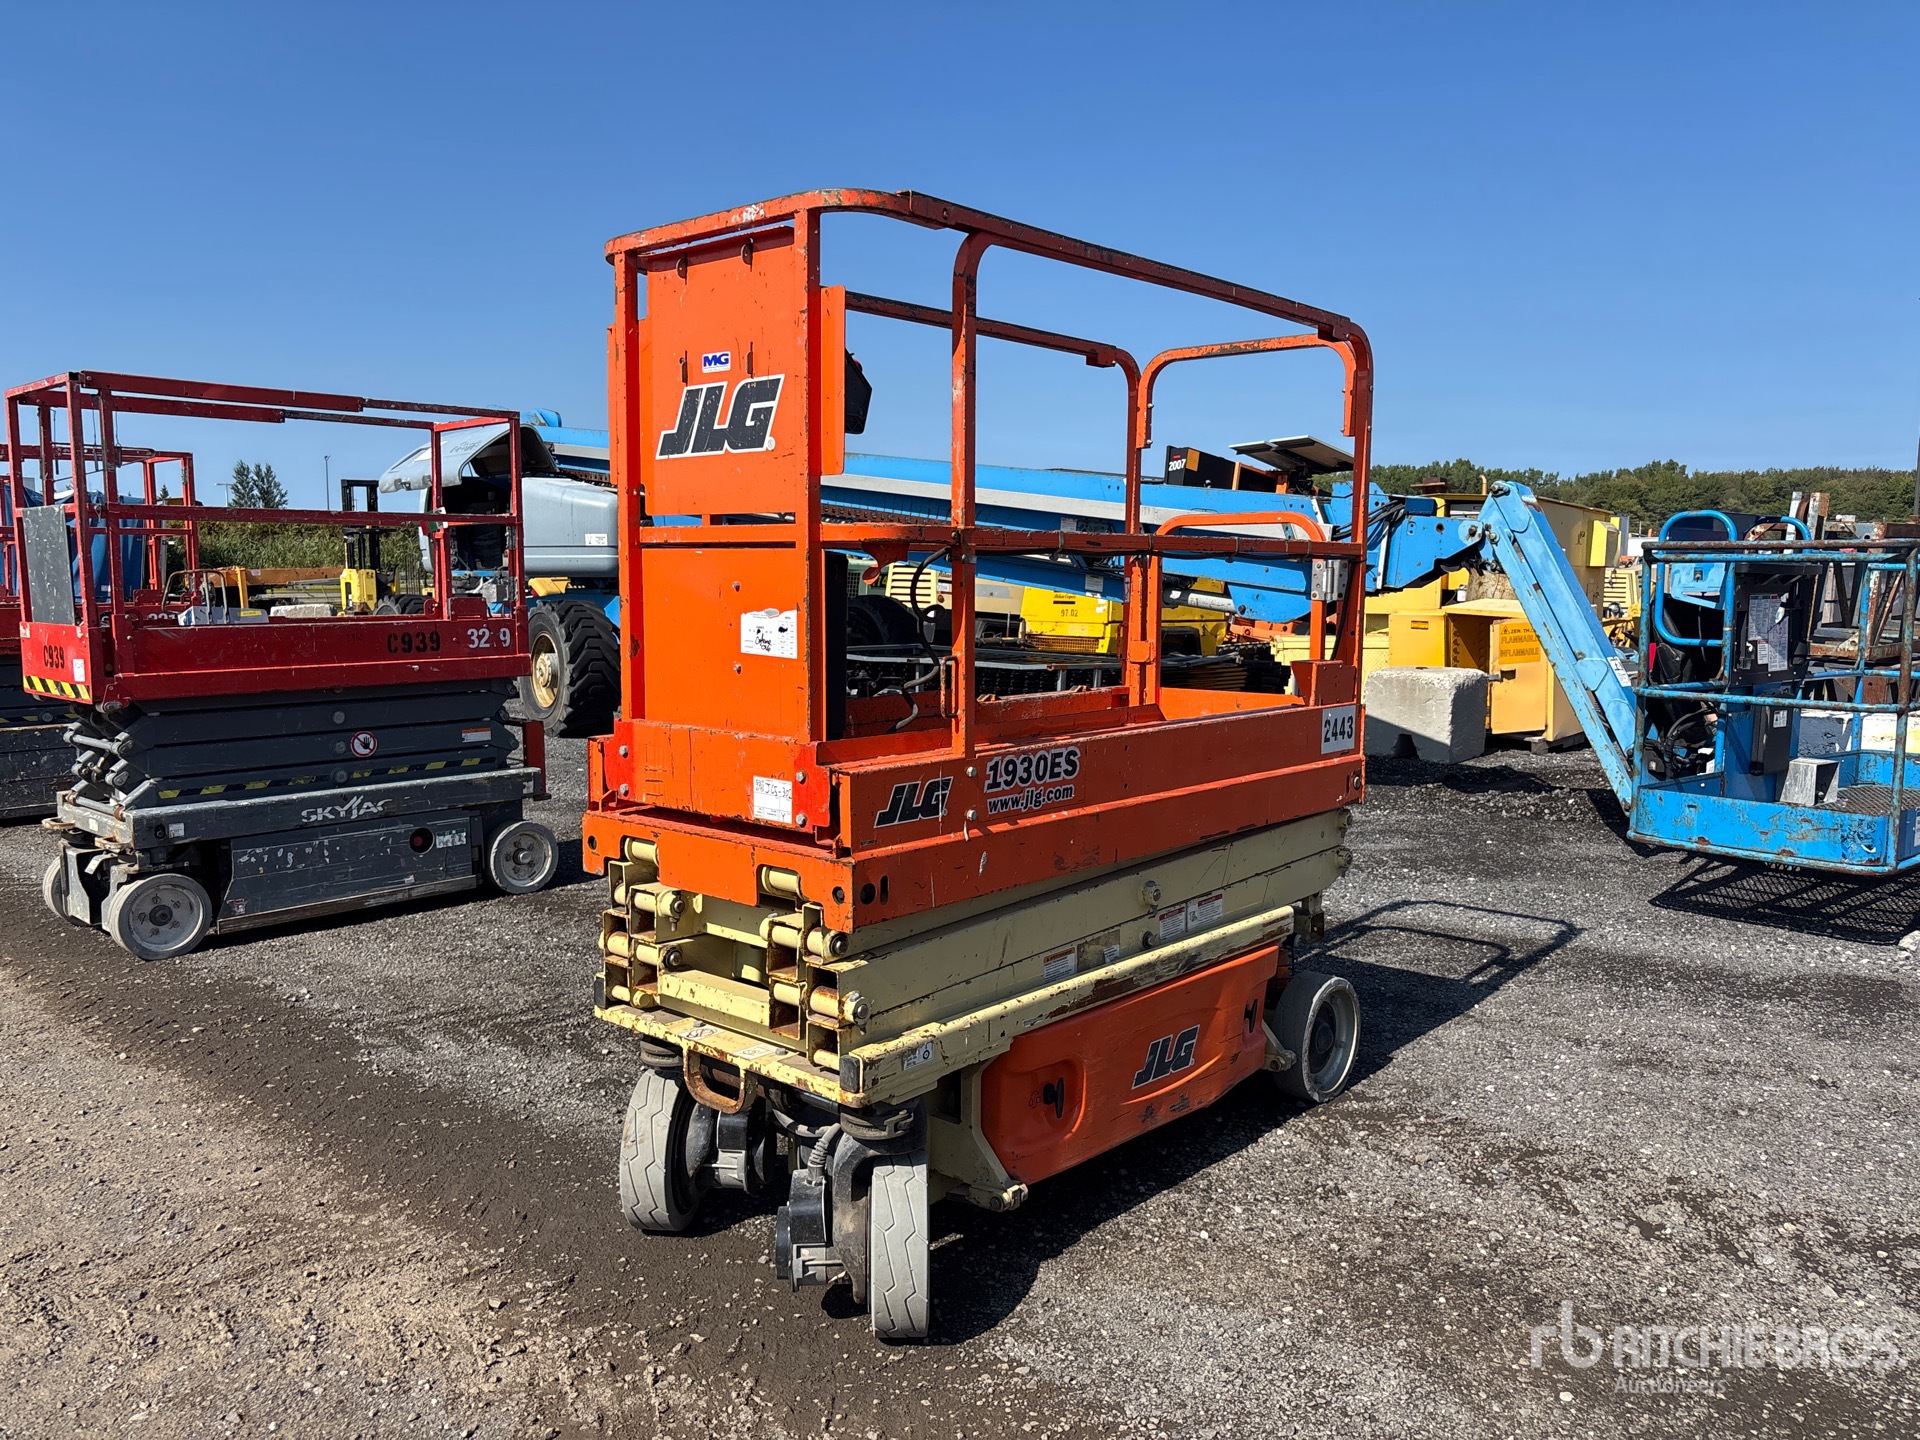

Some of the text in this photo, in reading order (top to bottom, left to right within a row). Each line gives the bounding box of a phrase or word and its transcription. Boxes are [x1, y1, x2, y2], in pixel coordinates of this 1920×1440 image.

[703, 353, 730, 367] MG
[656, 375, 784, 460] JLG
[1168, 458, 1187, 472] 2007
[386, 631, 441, 654] C939
[466, 627, 511, 648] 329
[43, 645, 65, 669] C939
[1323, 715, 1354, 743] 2443
[984, 746, 1081, 793] 1930ES
[874, 776, 953, 828] JLG
[986, 783, 1075, 815] www.jlg.com
[1131, 1024, 1200, 1090] JLG
